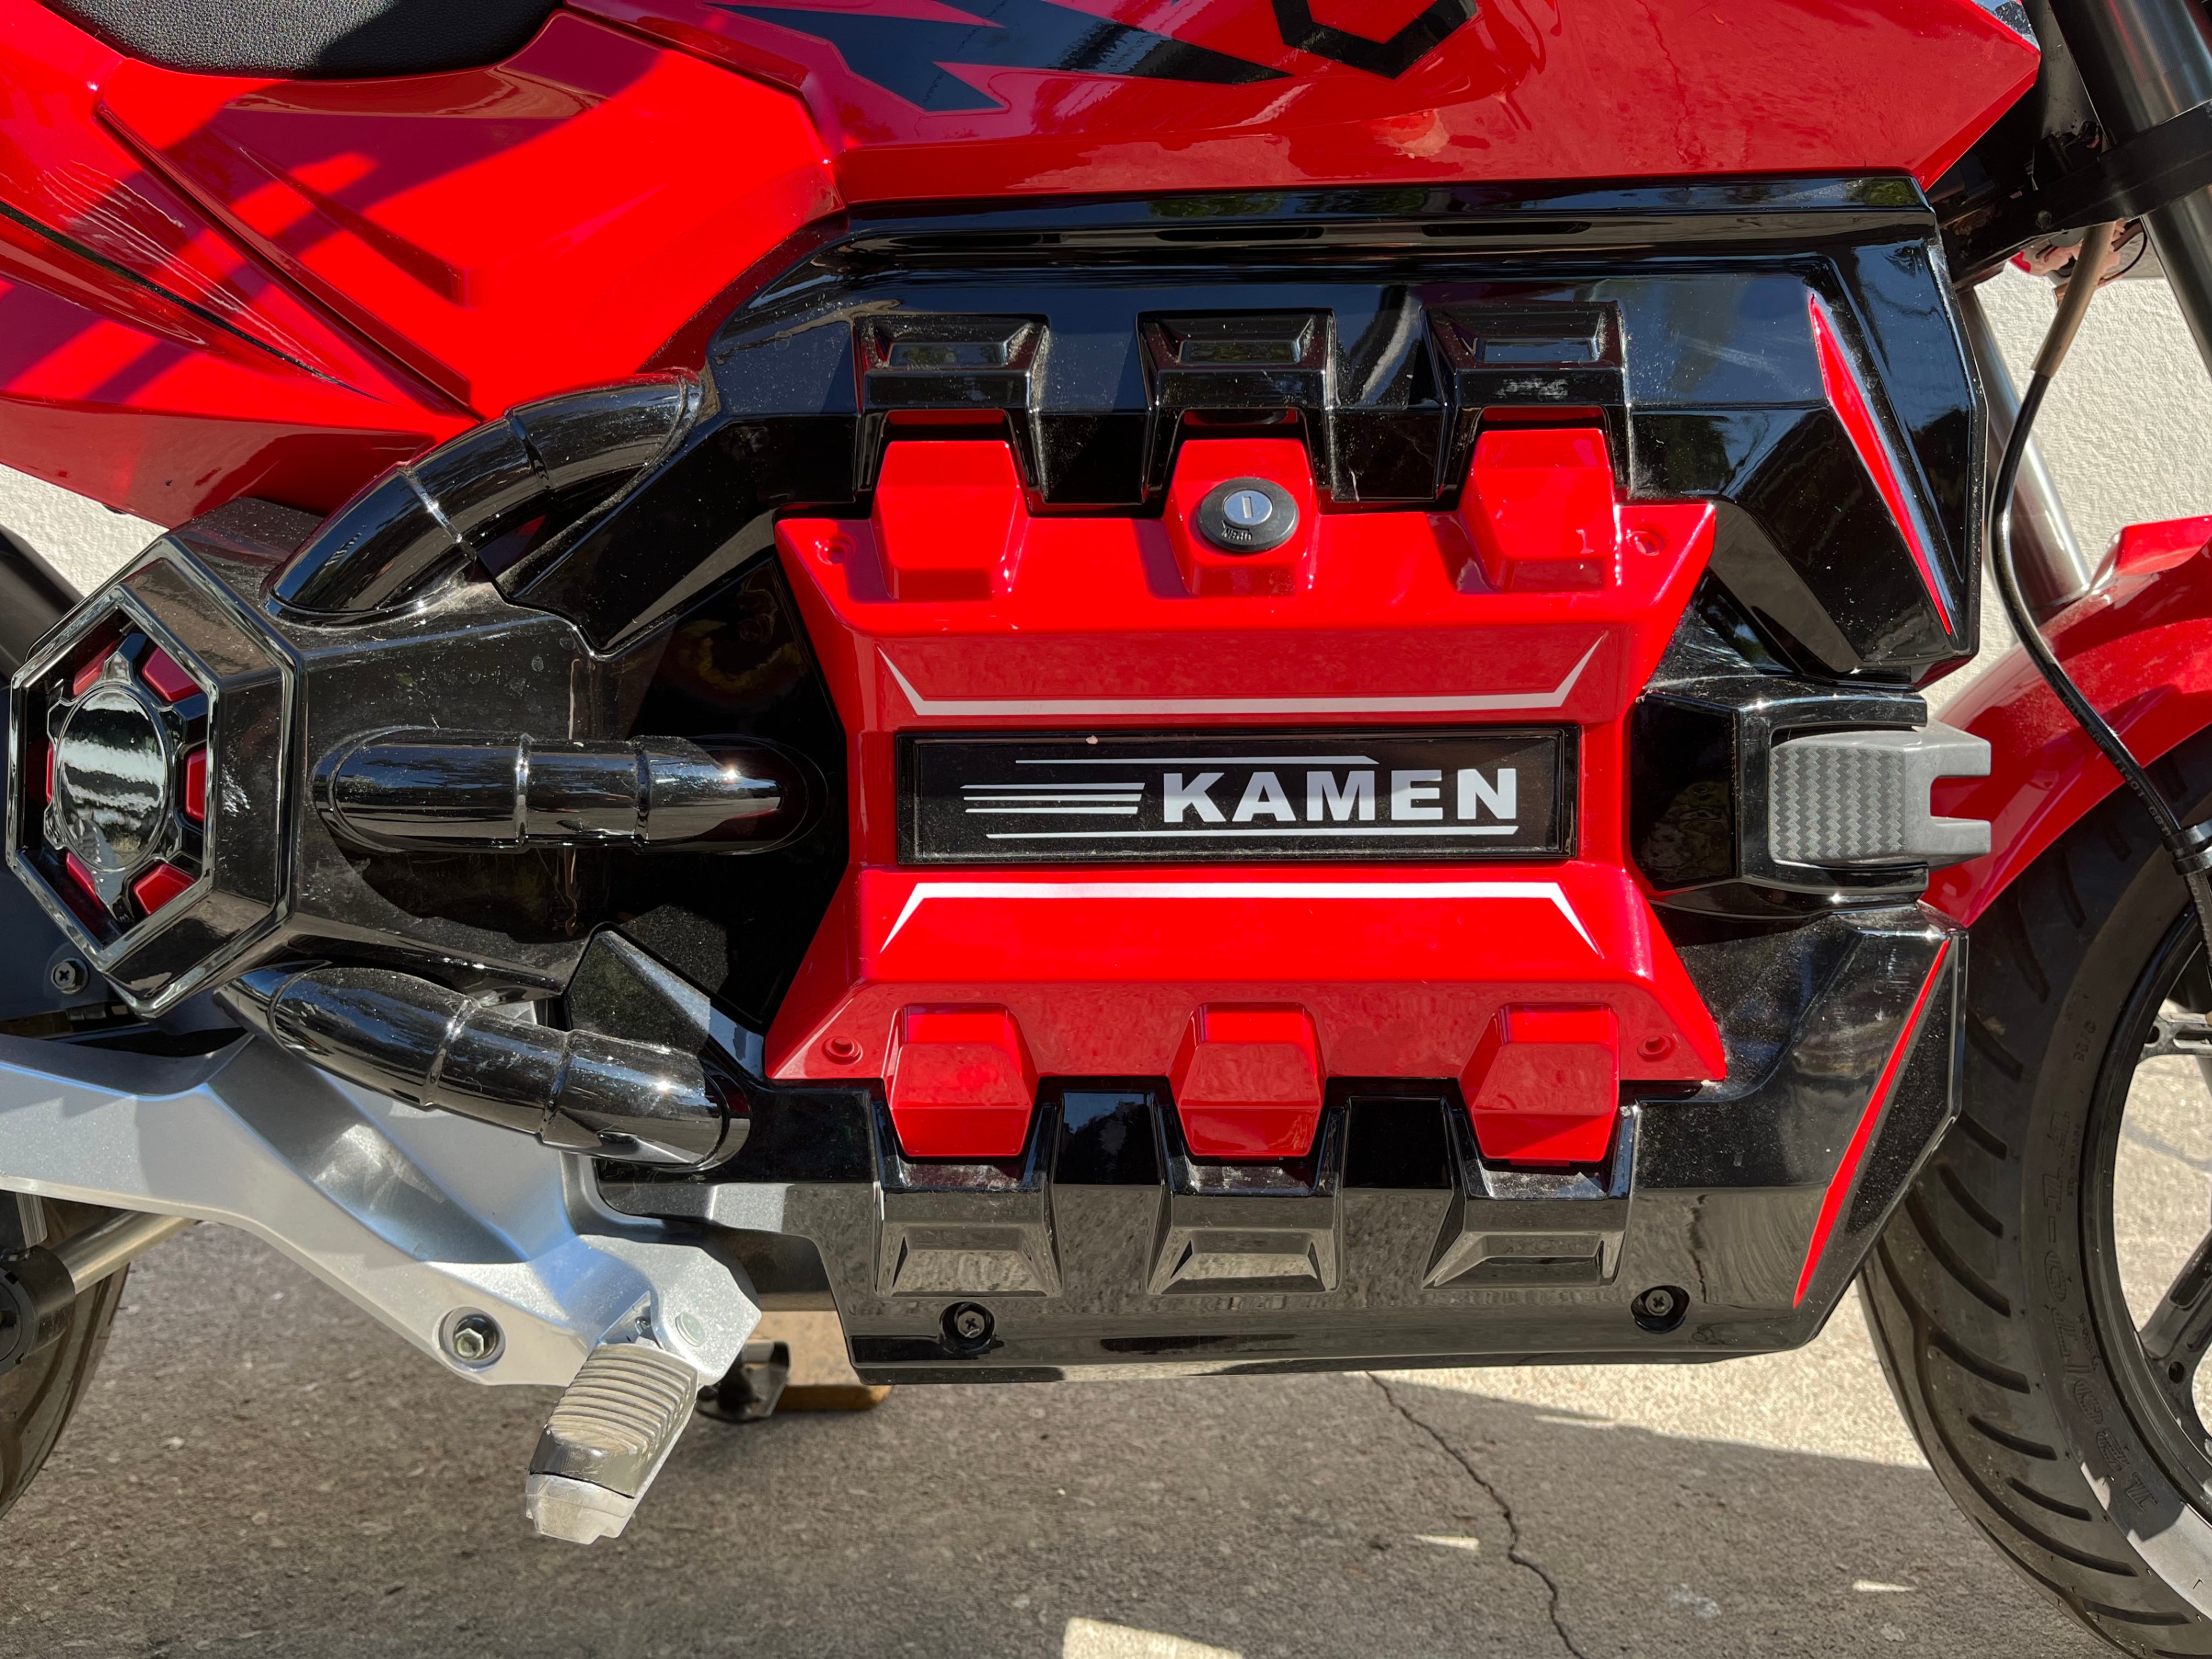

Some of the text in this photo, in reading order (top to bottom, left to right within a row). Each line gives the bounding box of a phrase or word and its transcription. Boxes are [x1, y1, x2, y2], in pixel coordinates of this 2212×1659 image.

[1222, 527, 1253, 541] OPEN
[2087, 727, 2108, 750] SAE
[2112, 758, 2145, 798] J1401
[1164, 768, 1516, 822] KAMEN
